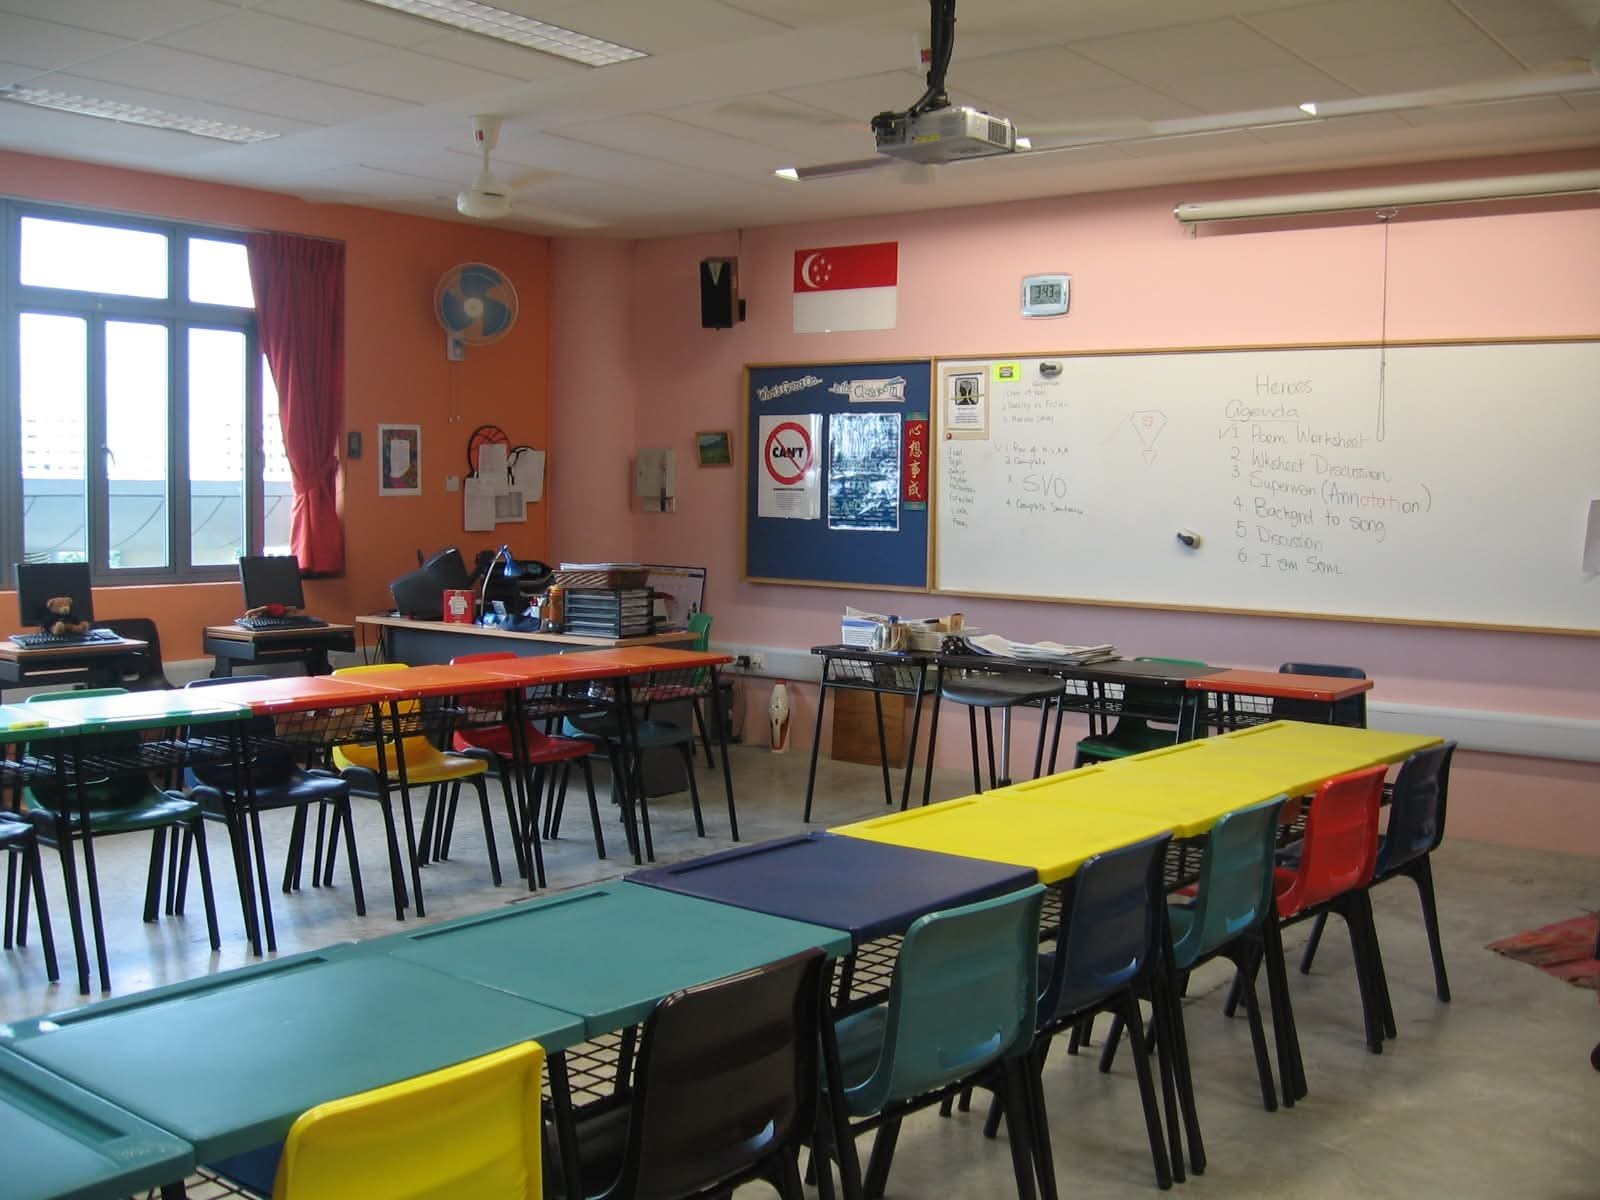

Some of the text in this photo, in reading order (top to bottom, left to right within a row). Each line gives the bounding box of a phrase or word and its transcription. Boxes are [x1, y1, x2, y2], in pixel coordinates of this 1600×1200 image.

[772, 446, 804, 459] CAN'T
[1325, 509, 1341, 526] to
[1235, 520, 1248, 539] 5
[1237, 547, 1248, 563] 6
[1260, 553, 1272, 568] I
